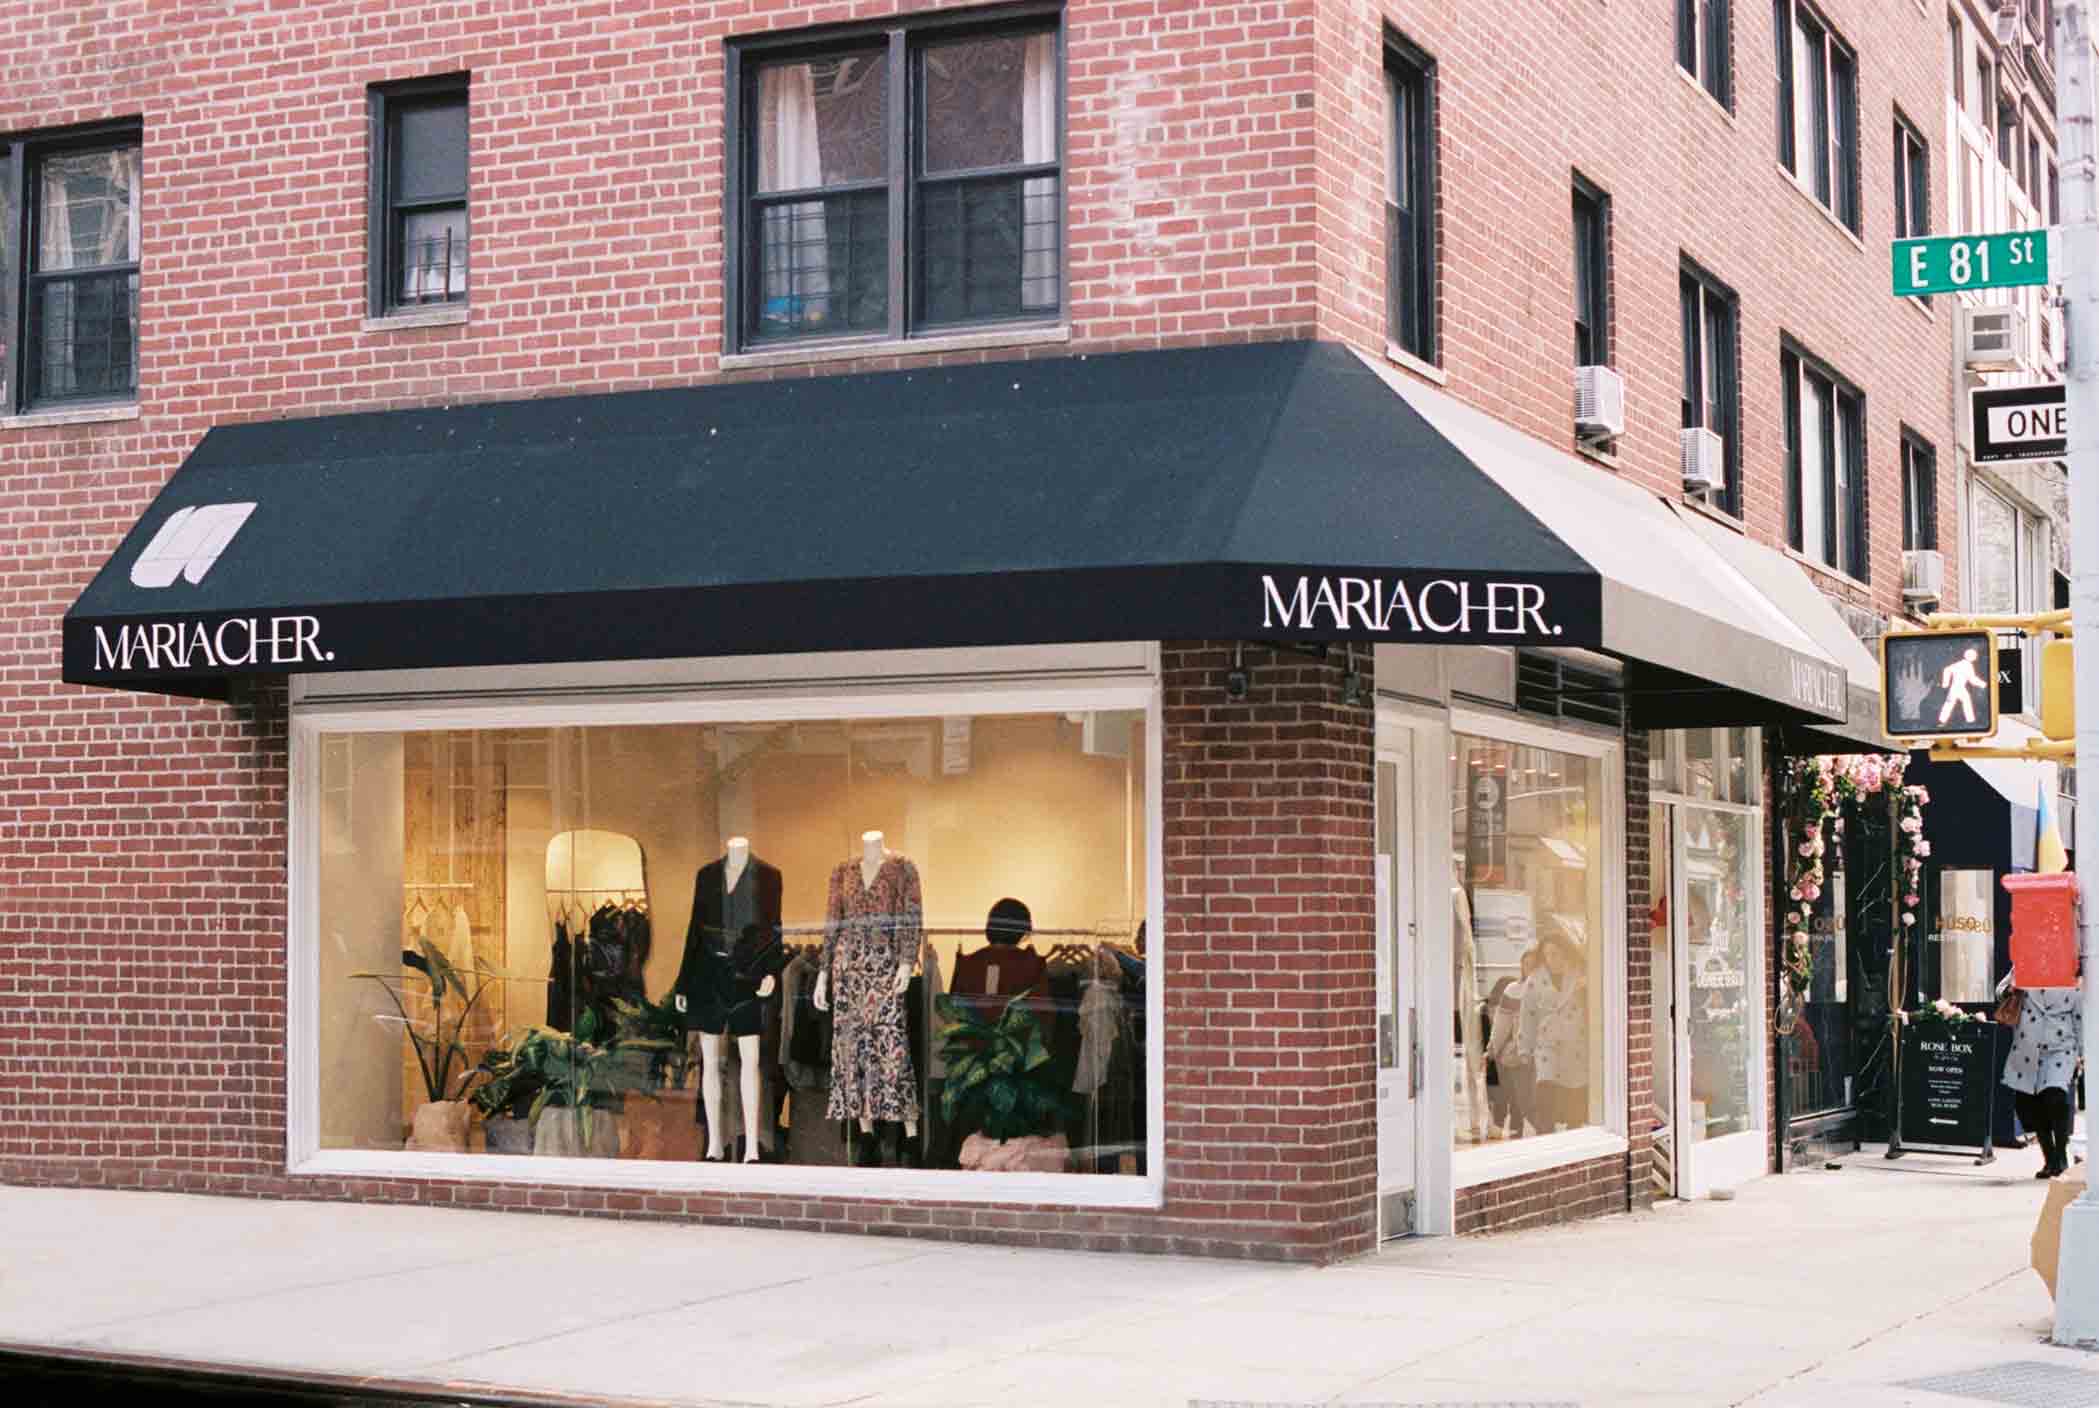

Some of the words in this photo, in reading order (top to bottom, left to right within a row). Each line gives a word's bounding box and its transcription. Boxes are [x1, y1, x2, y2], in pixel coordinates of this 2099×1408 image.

[1910, 245, 1929, 288] E
[1950, 241, 1990, 285] 81
[2009, 237, 2034, 265] St
[2007, 407, 2067, 437] ONE
[1262, 575, 1563, 635] MARIACHER.
[94, 615, 335, 670] MARIACHER.
[1951, 1042, 1973, 1054] BOX
